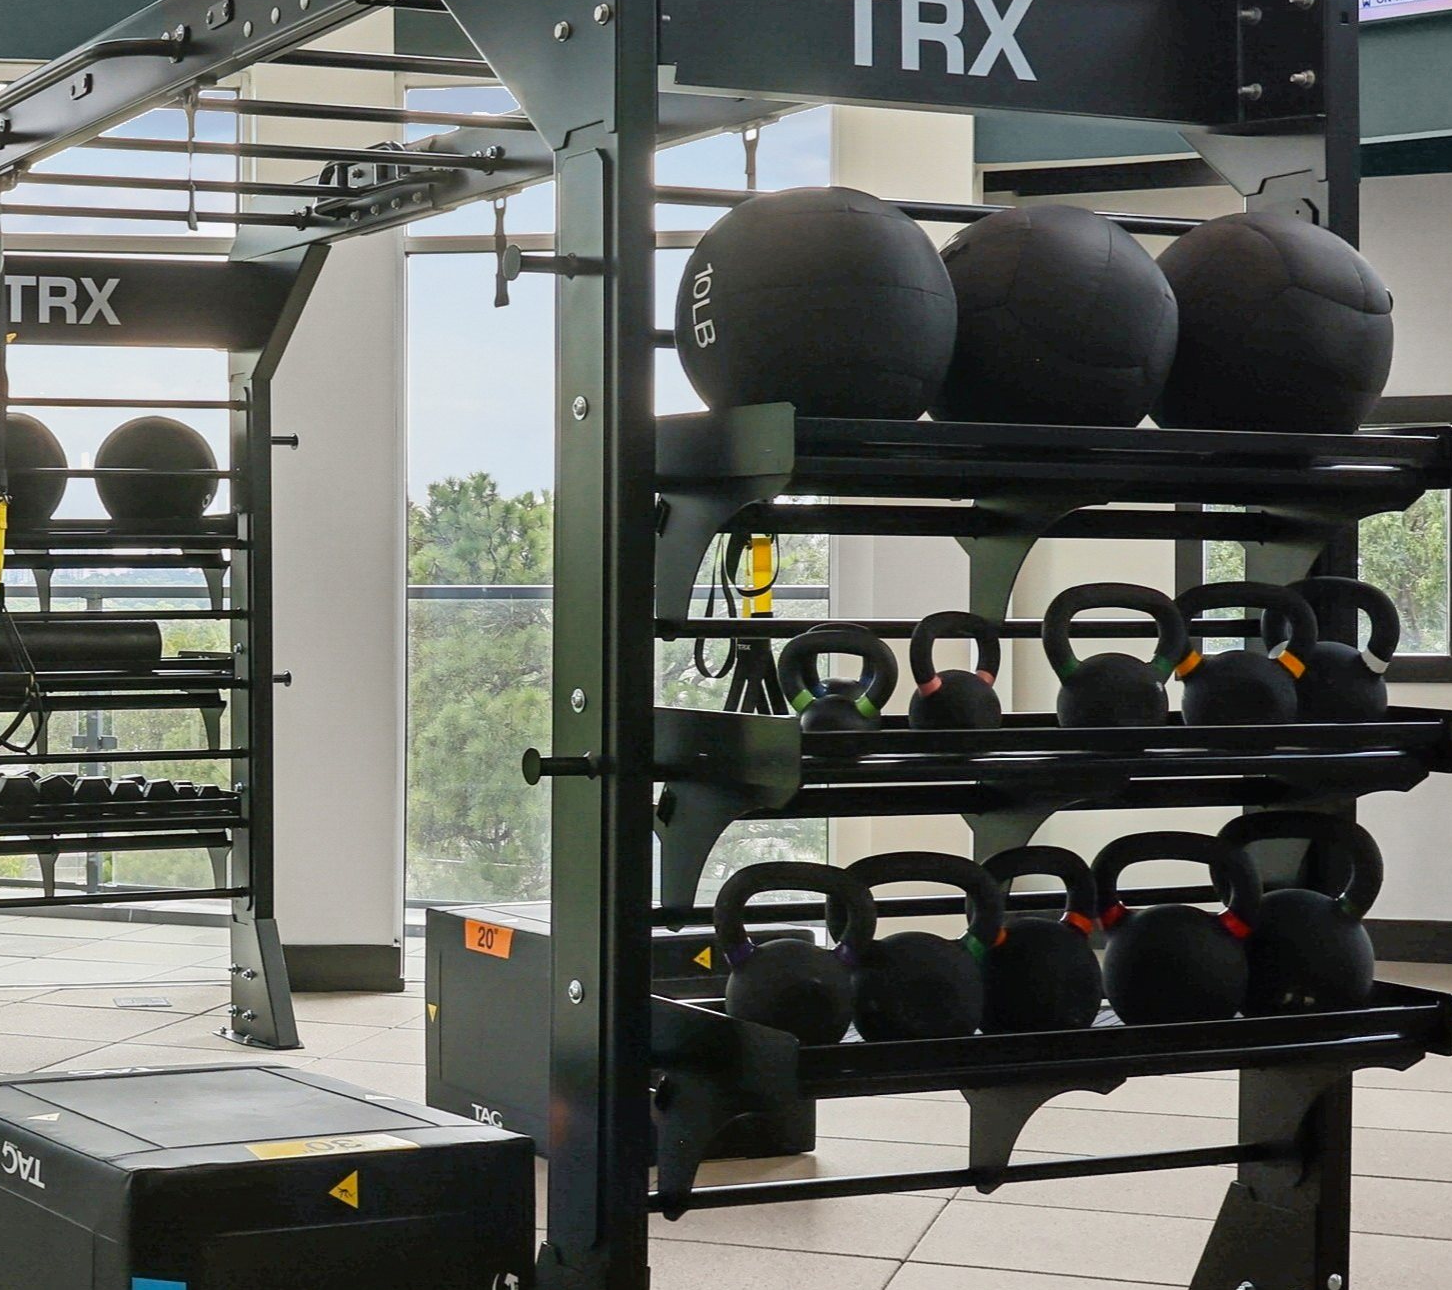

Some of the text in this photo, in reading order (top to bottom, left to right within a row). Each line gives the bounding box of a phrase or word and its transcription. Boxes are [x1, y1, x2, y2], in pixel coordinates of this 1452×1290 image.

[4, 274, 122, 326] TRX
[692, 262, 716, 349] 10LB
[0, 1140, 46, 1189] TAG
